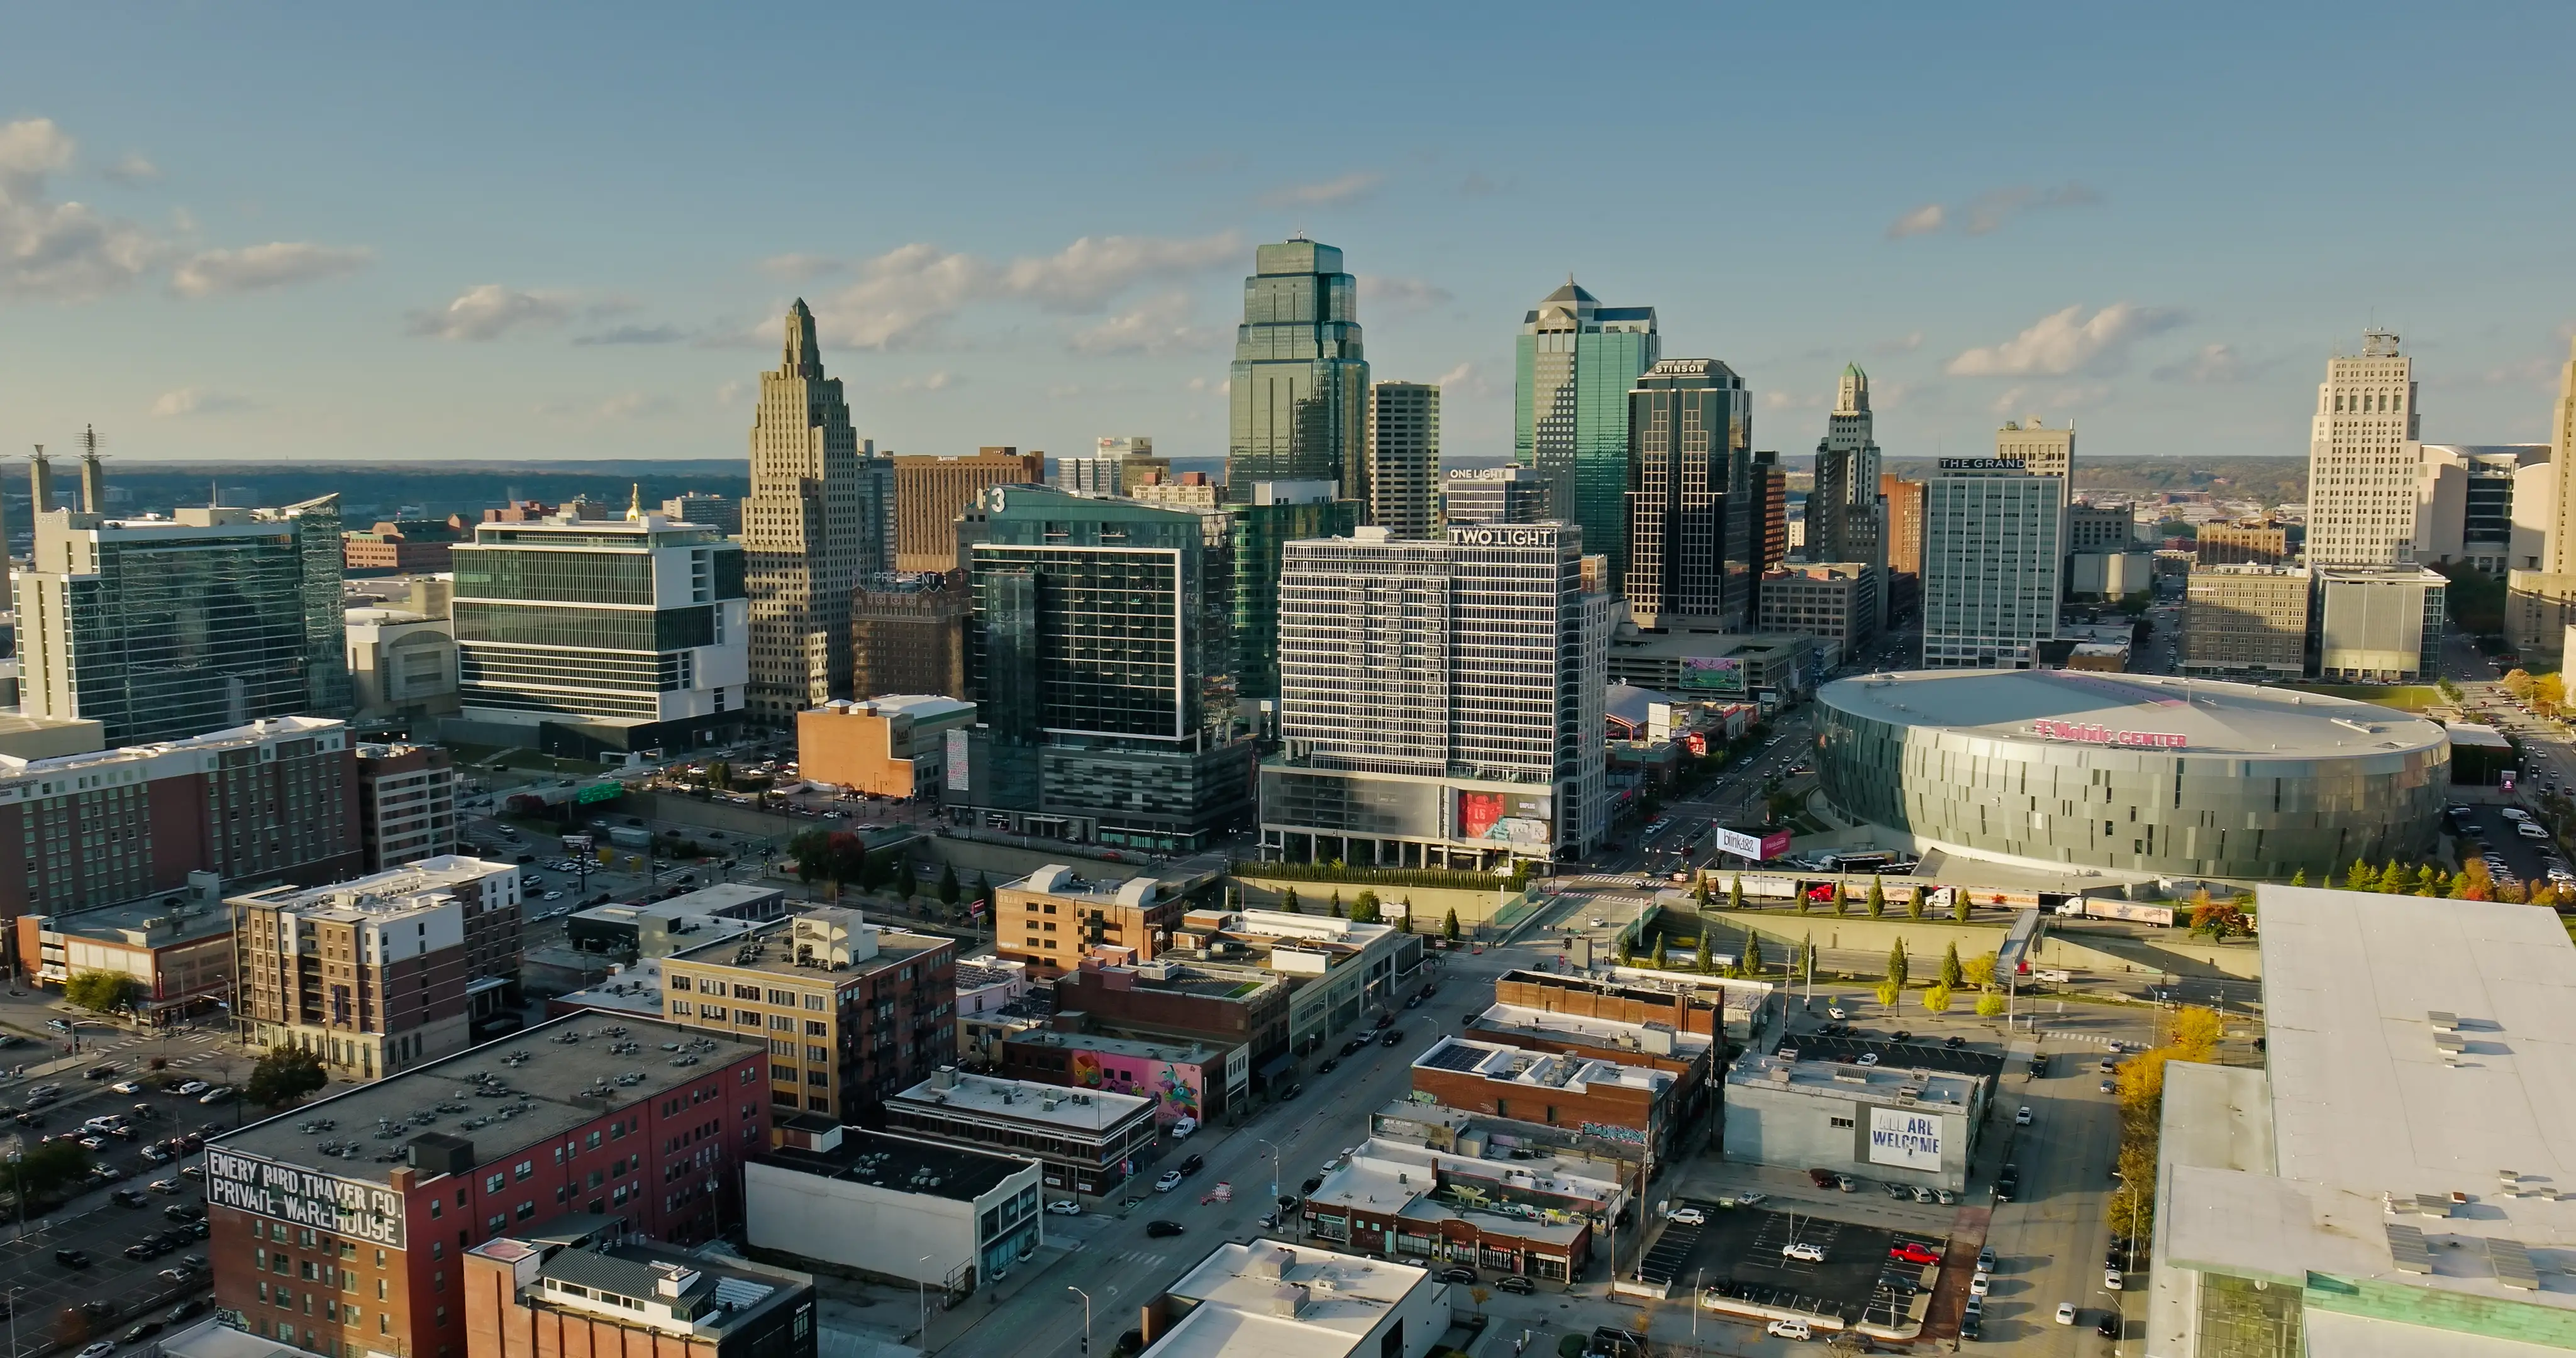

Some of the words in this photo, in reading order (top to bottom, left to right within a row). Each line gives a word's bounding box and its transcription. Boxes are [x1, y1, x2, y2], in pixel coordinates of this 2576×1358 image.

[1655, 364, 1704, 373] STINSON
[1941, 459, 1970, 468] THE
[1974, 459, 2026, 468] GRAND
[1450, 469, 1472, 479] ONE
[1474, 470, 1504, 479] LIGHT
[991, 487, 1005, 512] 3
[1452, 530, 1492, 545] TWO
[1497, 530, 1550, 545] LIGHT
[874, 572, 937, 584] PRESIDENT
[1879, 1114, 1904, 1132] ALL
[1907, 1117, 1933, 1135] ARE
[1873, 1130, 1940, 1154] WELCOME
[209, 1152, 257, 1183] EMERY
[303, 1173, 367, 1210] THAYER
[372, 1191, 402, 1219] CO.
[796, 1302, 811, 1315] Native
